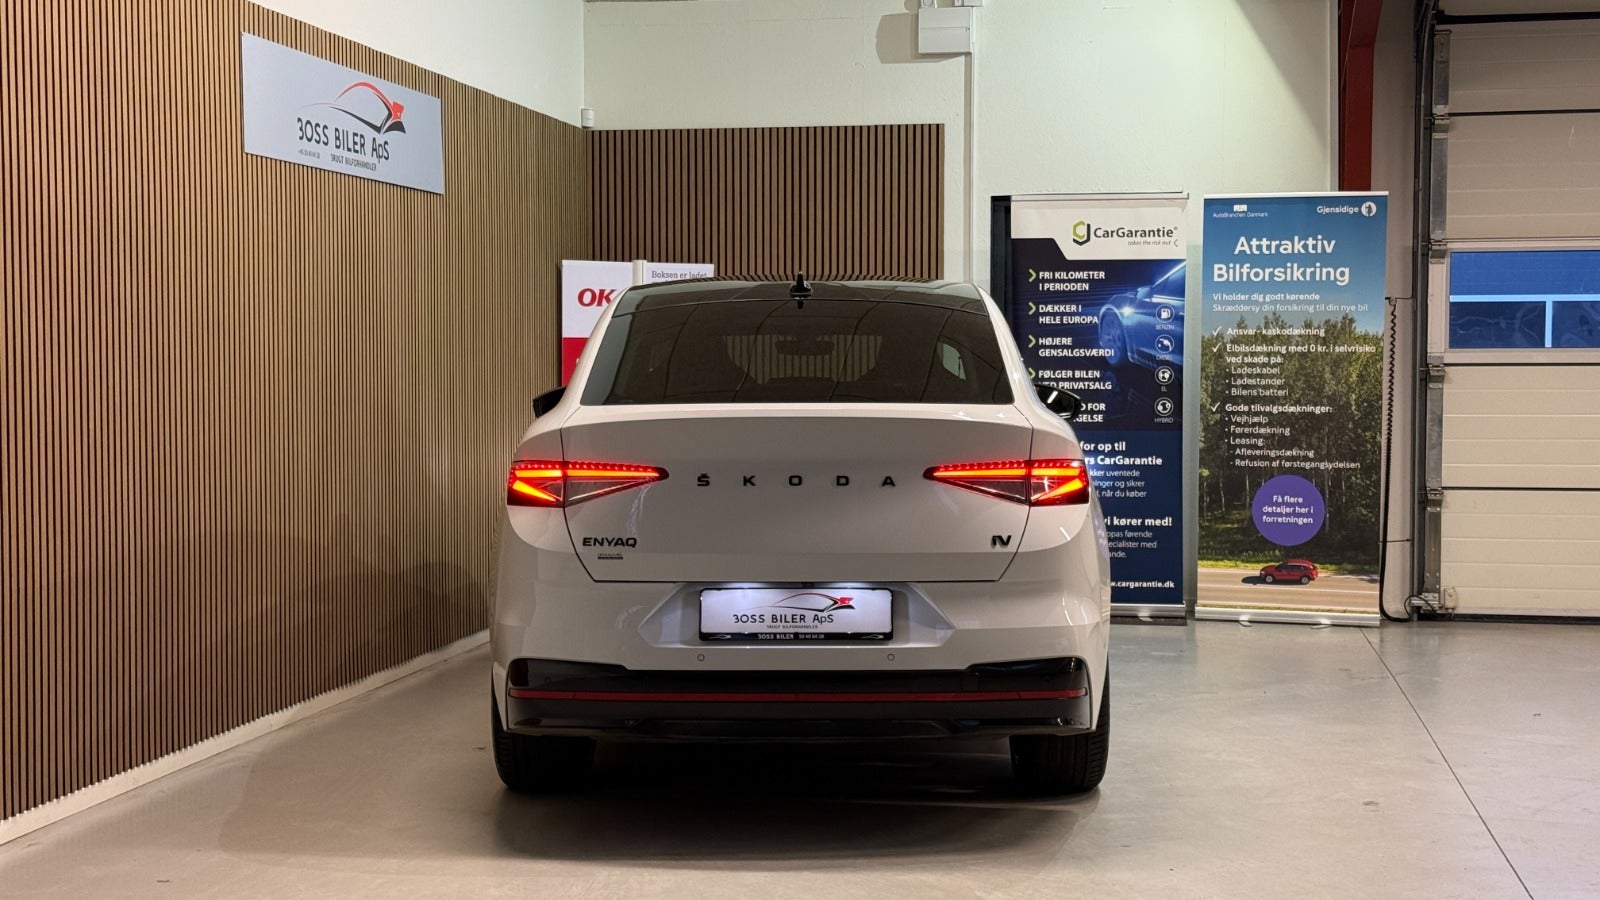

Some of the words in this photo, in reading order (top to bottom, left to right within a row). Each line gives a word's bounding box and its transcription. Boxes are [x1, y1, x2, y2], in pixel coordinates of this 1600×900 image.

[334, 127, 366, 156] BILER
[371, 137, 390, 164] ApS
[344, 156, 376, 171] BILFORHANDLER
[1317, 205, 1359, 215] Gjensidige
[1234, 235, 1336, 255] Attraktiv
[651, 270, 678, 279] Boksen
[1039, 271, 1052, 280] FRI
[1055, 271, 1105, 280] KILOMETER
[1214, 263, 1350, 286] Bilforsikring
[1044, 283, 1089, 291] PERIODEN
[578, 288, 616, 307] OK
[1251, 293, 1263, 302] dig
[1265, 293, 1285, 302] godt
[1039, 305, 1076, 313] DÆKKER
[1213, 304, 1260, 313] Skræddersy
[1276, 304, 1314, 313] forsikring
[1039, 316, 1060, 324] HELE
[1063, 316, 1099, 324] EUROPA
[1262, 328, 1325, 337] kaskodækning
[1039, 337, 1072, 346] HØJERE
[1039, 349, 1114, 357] GENSALGSVÆRDI
[1227, 344, 1286, 354] Elbilsdækning
[1271, 355, 1284, 364] på:
[1039, 370, 1073, 378] FØLGER
[1075, 370, 1100, 378] BILEN
[1225, 404, 1249, 412] Gode
[1251, 404, 1332, 414] tilvalgsdækninger:
[1231, 415, 1268, 424] Vejhjælp
[1230, 426, 1290, 435] Førerdækning
[1230, 437, 1265, 446] Leasing:
[1080, 441, 1095, 450] for
[1098, 443, 1112, 452] op
[1114, 441, 1126, 450] til
[1235, 449, 1315, 458] Afleveringsdækning
[1097, 455, 1162, 465] CarGarantie
[1262, 505, 1293, 514] detaljer
[1113, 516, 1142, 526] kører
[1145, 517, 1172, 526] med!
[1263, 515, 1313, 525] forretningen
[582, 537, 637, 548] ENYAQ
[771, 614, 806, 623] BILER
[812, 614, 834, 625] ApS
